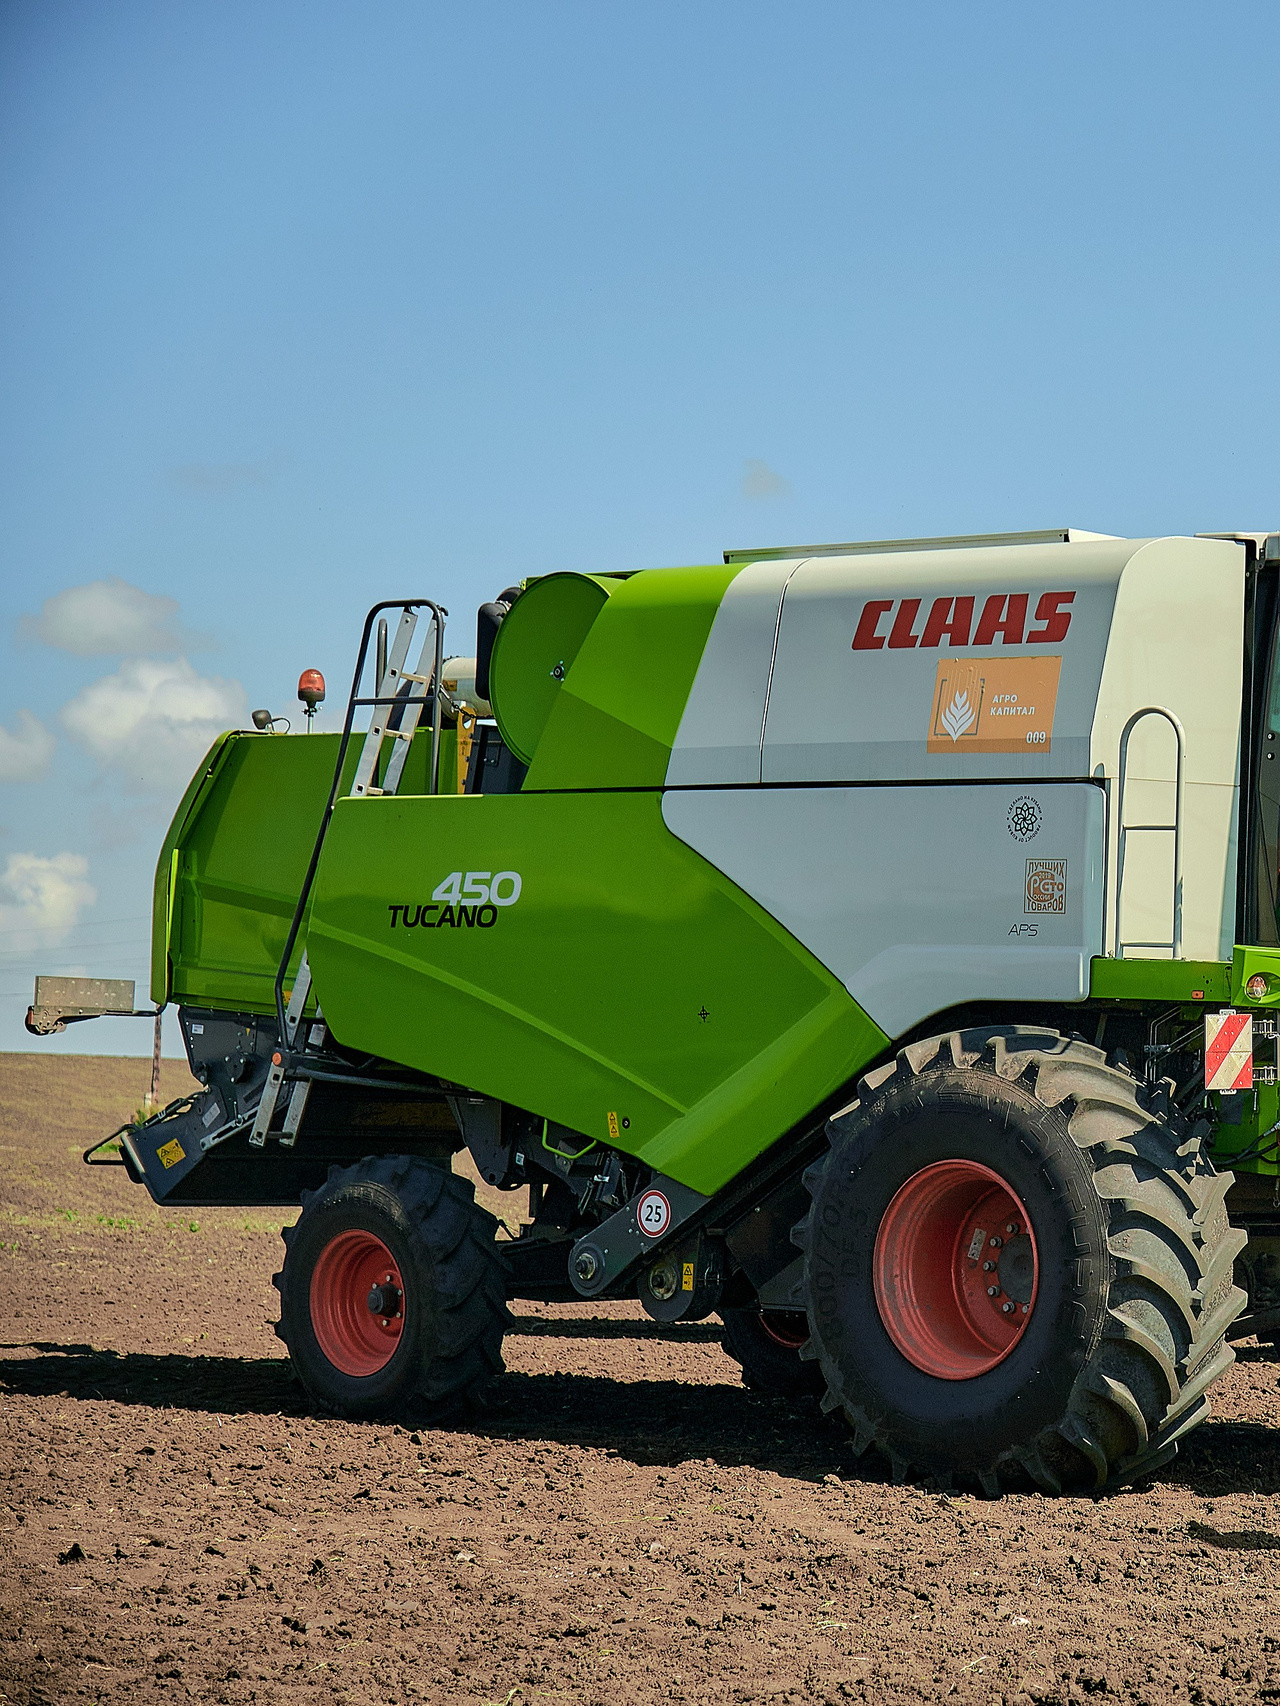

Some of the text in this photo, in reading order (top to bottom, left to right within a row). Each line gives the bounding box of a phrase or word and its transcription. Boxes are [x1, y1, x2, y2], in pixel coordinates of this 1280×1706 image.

[851, 590, 1077, 651] CLAAS
[992, 694, 1018, 704] АГРО
[990, 706, 1035, 716] КАПИТАЛ
[1026, 731, 1046, 744] 009
[1027, 861, 1065, 880] ЛУЧШИХ
[432, 871, 522, 906] 450
[1026, 893, 1064, 912] ТОВАРОВ
[388, 904, 498, 928] TUCANO
[1008, 923, 1039, 937] APS
[645, 1204, 662, 1223] 25
